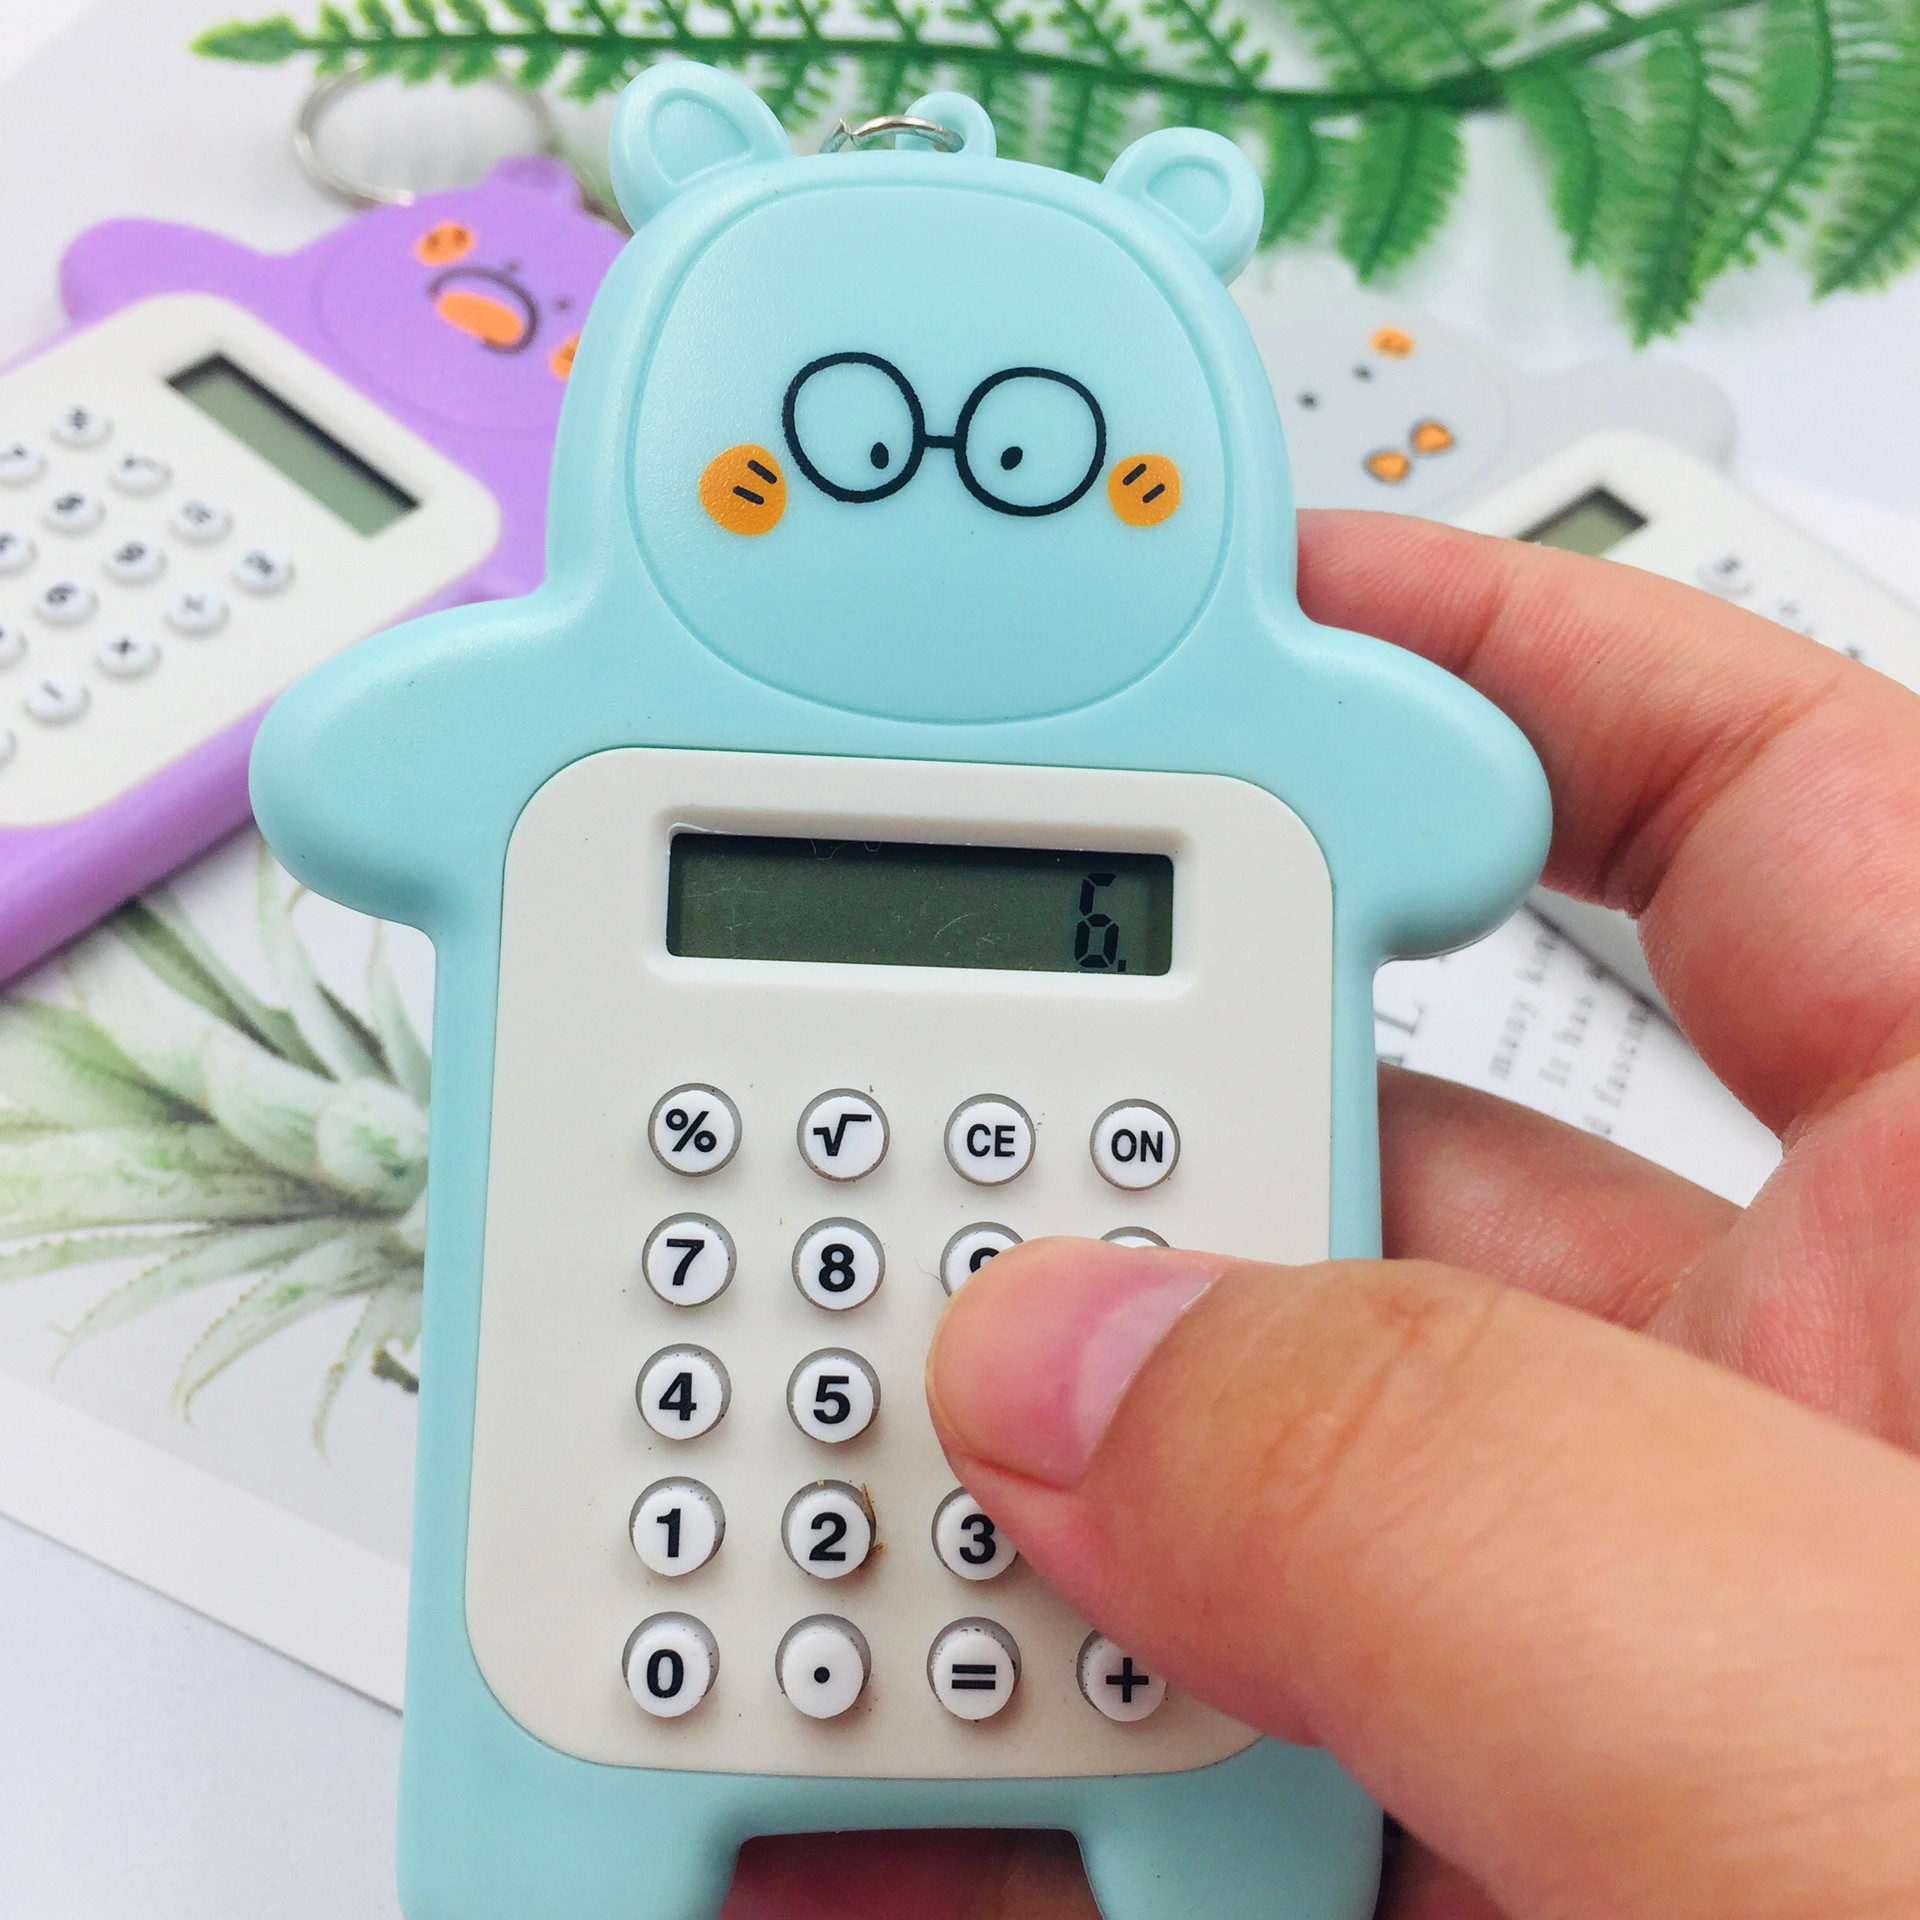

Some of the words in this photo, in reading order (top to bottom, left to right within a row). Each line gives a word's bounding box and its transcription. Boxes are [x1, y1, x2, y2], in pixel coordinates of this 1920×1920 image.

[966, 1123, 1016, 1158] CE
[1110, 1129, 1164, 1164] ON
[666, 1238, 705, 1287] 7
[818, 1243, 856, 1293] 8
[658, 1372, 698, 1421] 4
[812, 1375, 851, 1425] 5
[656, 1507, 682, 1558] 1
[808, 1511, 848, 1562] 2
[958, 1513, 996, 1564] 3
[646, 1648, 685, 1699] 0
